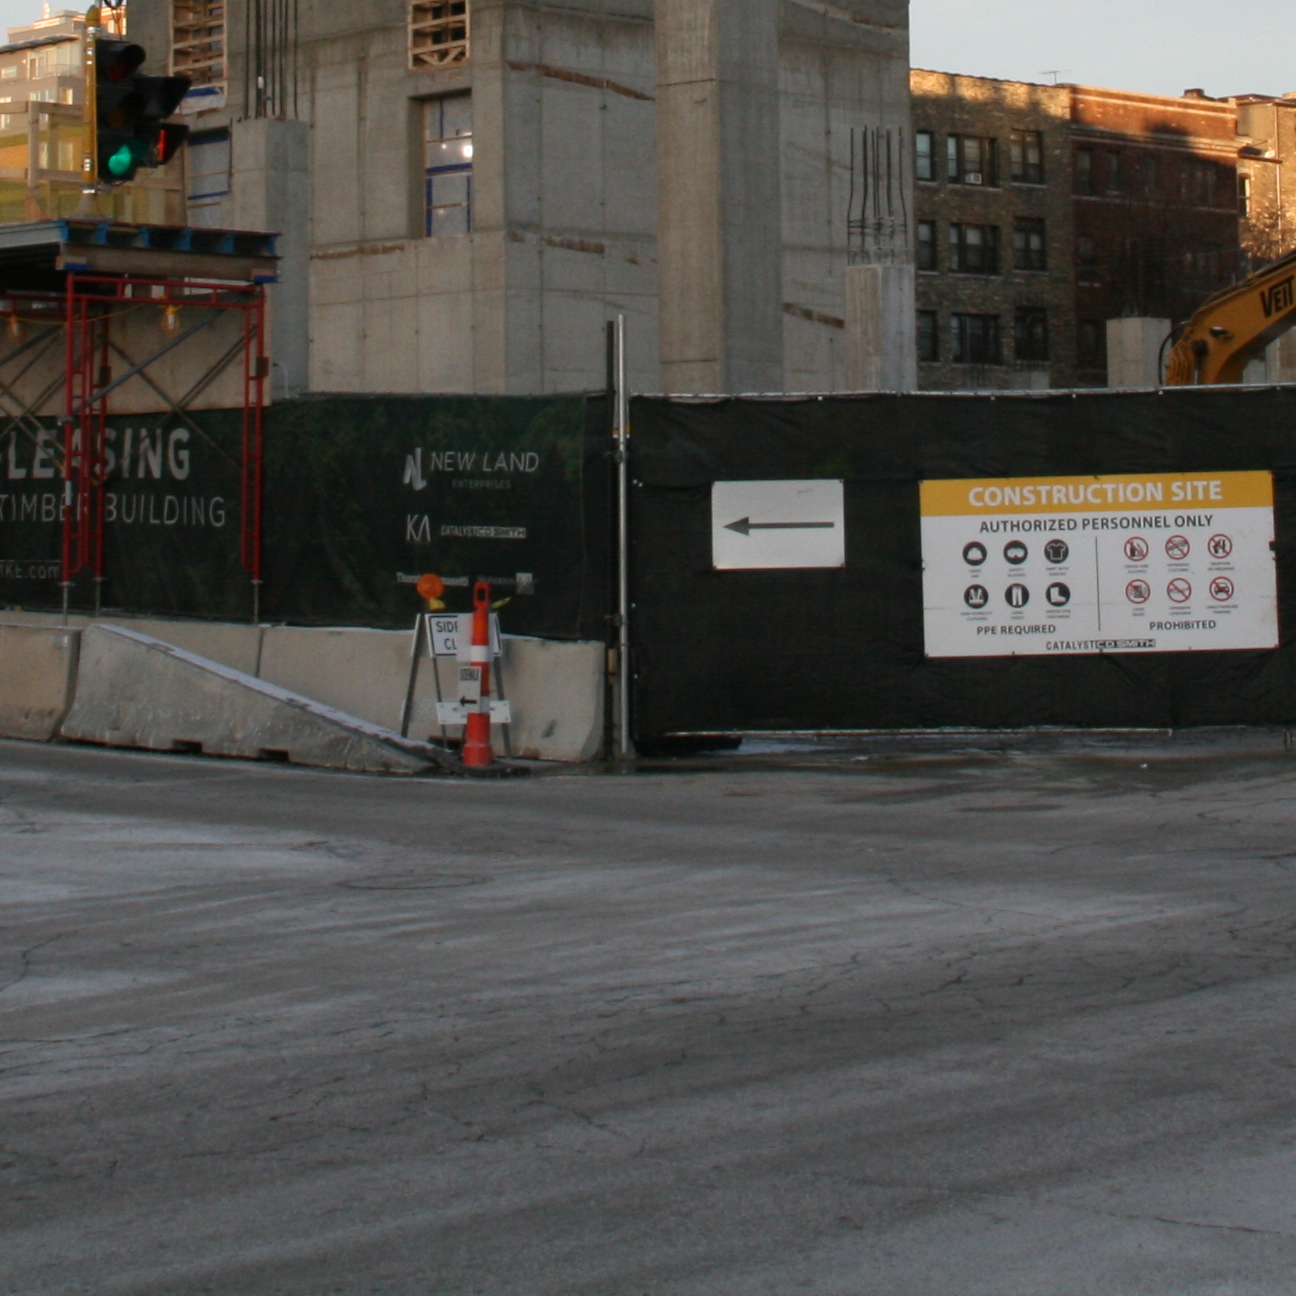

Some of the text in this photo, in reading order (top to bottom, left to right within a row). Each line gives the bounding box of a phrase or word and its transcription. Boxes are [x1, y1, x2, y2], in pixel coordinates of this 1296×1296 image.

[1260, 274, 1295, 318] VEIT
[431, 451, 476, 472] NEW
[482, 452, 539, 473] LAND
[968, 480, 1223, 507] CONSTRUCTION SITE
[104, 494, 226, 528] BUILDING
[979, 514, 1213, 533] AUTHORIZED PERSONNEL ONLY
[977, 620, 1216, 635] PPE REQUIRED PROHIBITED
[1046, 640, 1095, 651] CATALYST
